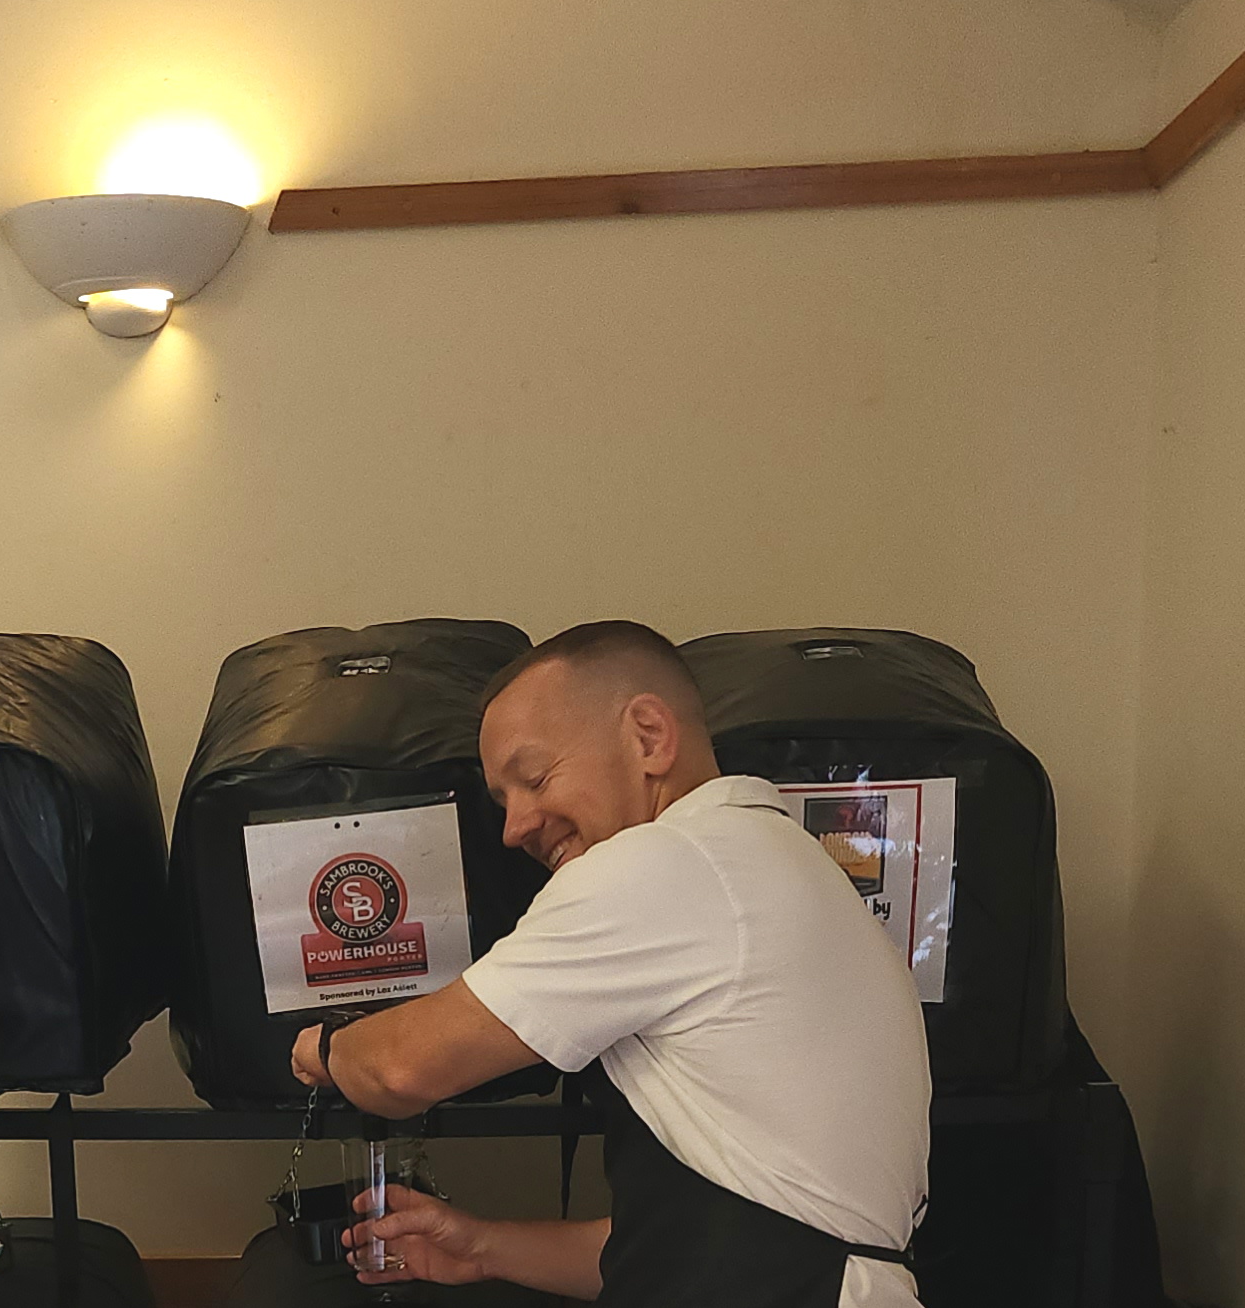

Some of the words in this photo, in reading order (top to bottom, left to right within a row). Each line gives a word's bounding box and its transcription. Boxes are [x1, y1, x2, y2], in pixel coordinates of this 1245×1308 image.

[319, 862, 394, 896] SAMBROOK'S
[872, 898, 891, 920] by
[331, 914, 391, 939] BREWERY
[306, 940, 418, 964] POWERHOUSE
[319, 988, 364, 1001] Sponsored
[365, 987, 376, 998] by
